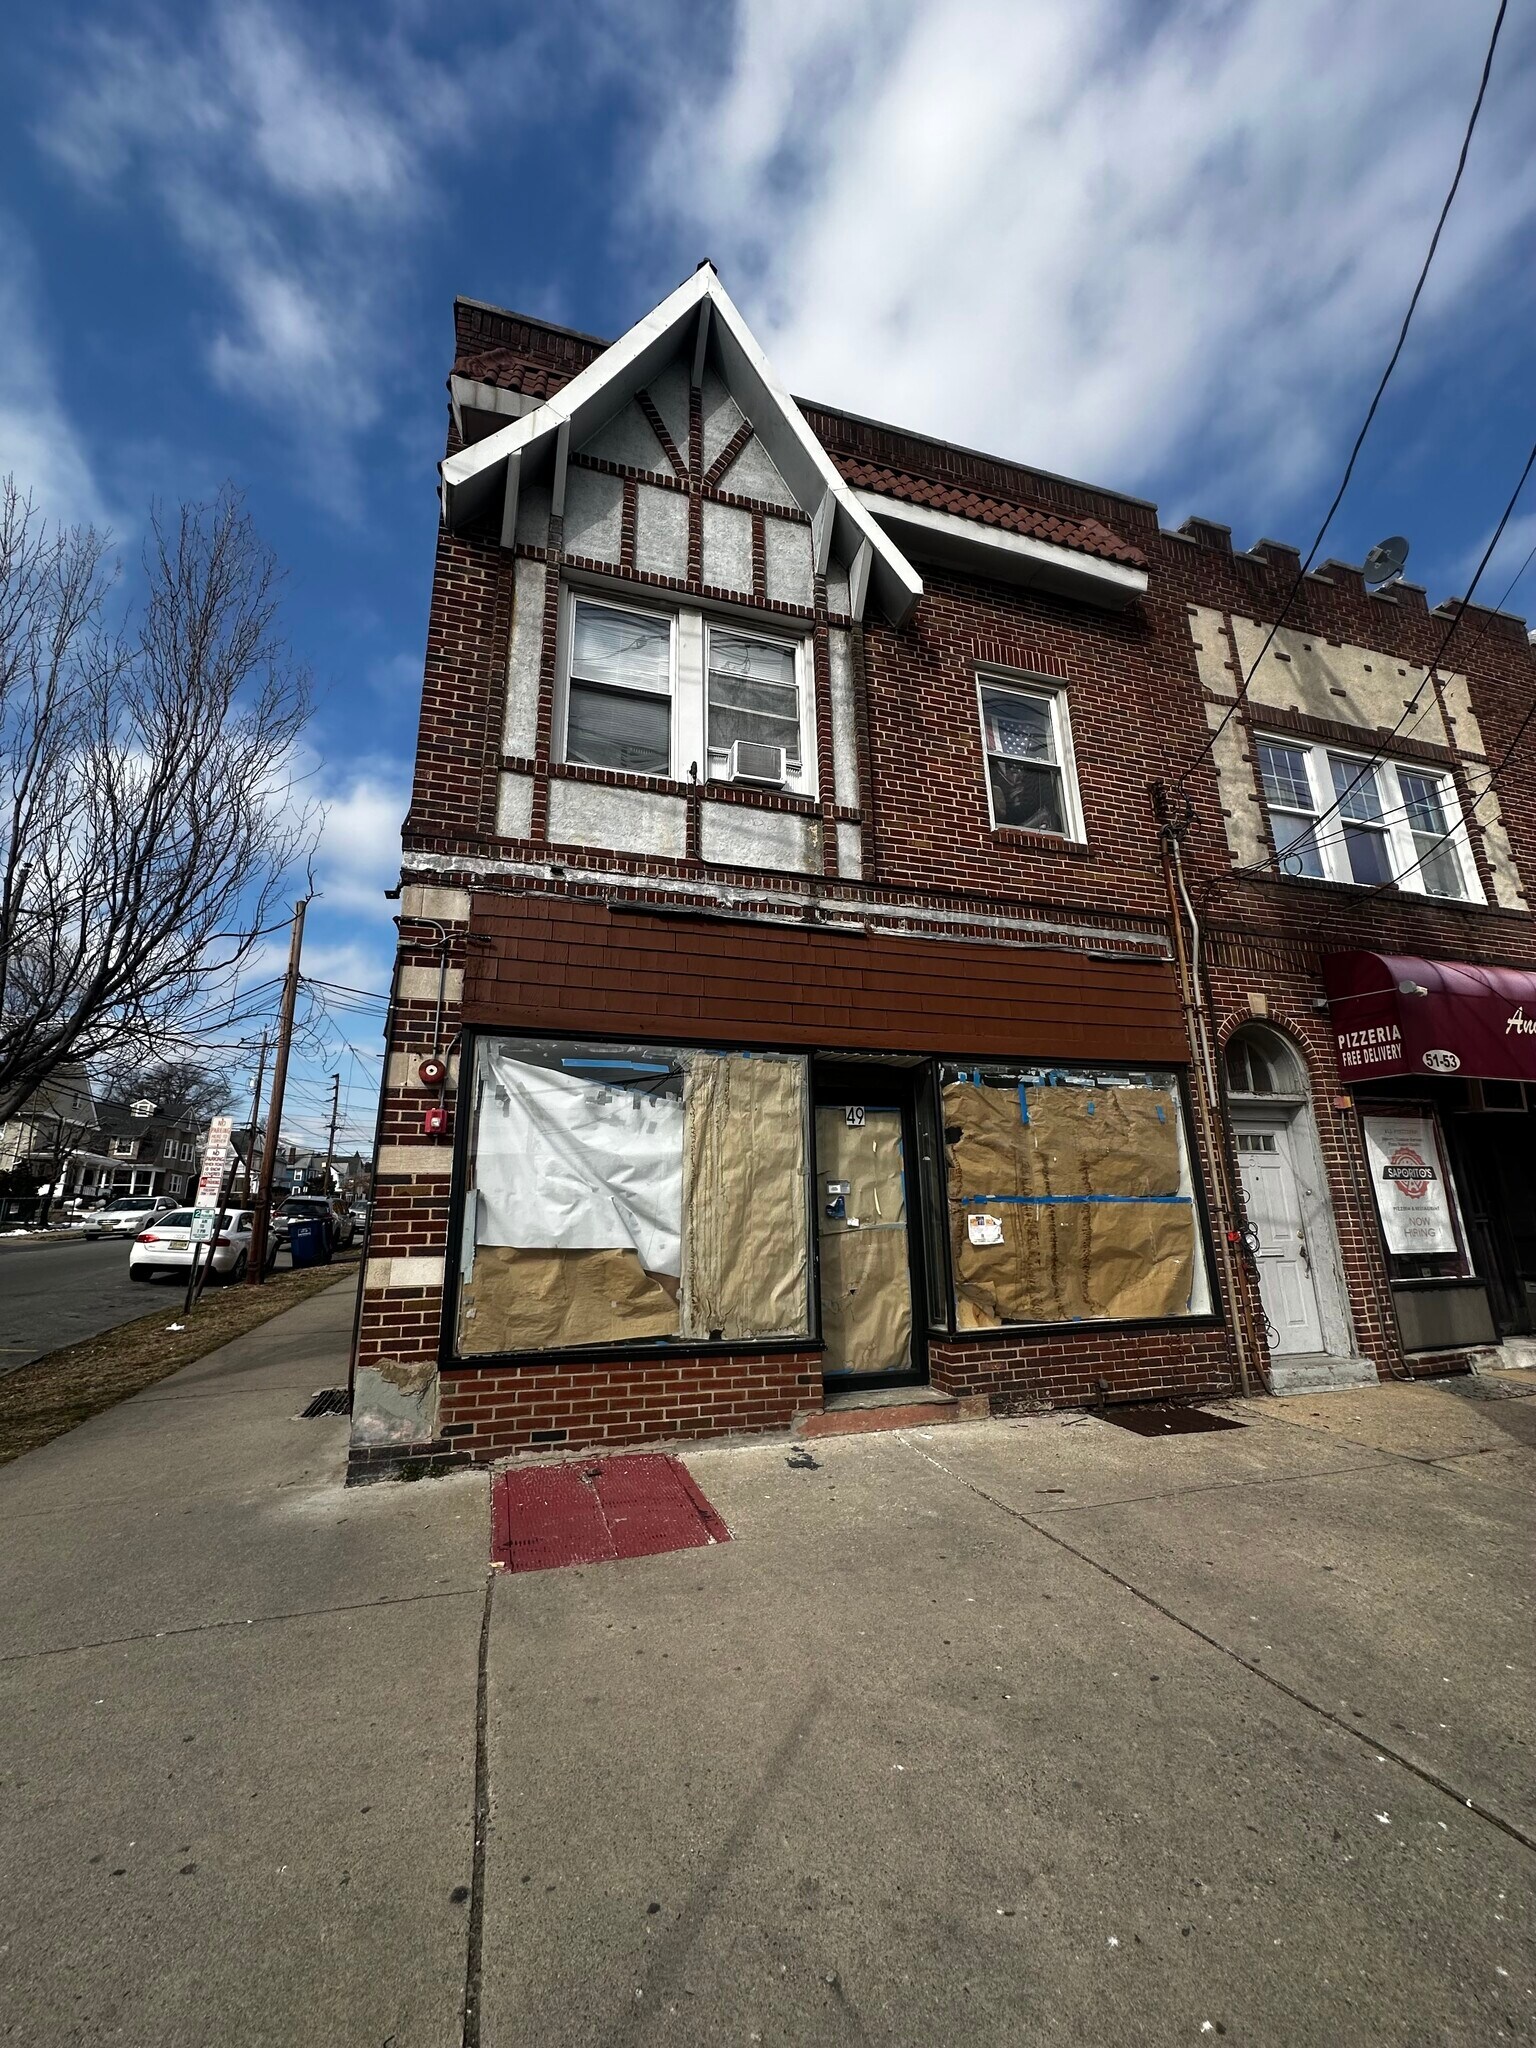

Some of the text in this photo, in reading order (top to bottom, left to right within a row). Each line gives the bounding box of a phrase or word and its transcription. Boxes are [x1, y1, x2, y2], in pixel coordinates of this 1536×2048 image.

[1338, 1024, 1402, 1050] PIZZERIA
[1342, 1043, 1402, 1067] FREE DELIVERY
[1425, 1053, 1458, 1069] 51-53
[846, 1107, 864, 1125] 49
[1387, 1167, 1433, 1178] SAPORITO'S
[1408, 1217, 1431, 1227] NOW
